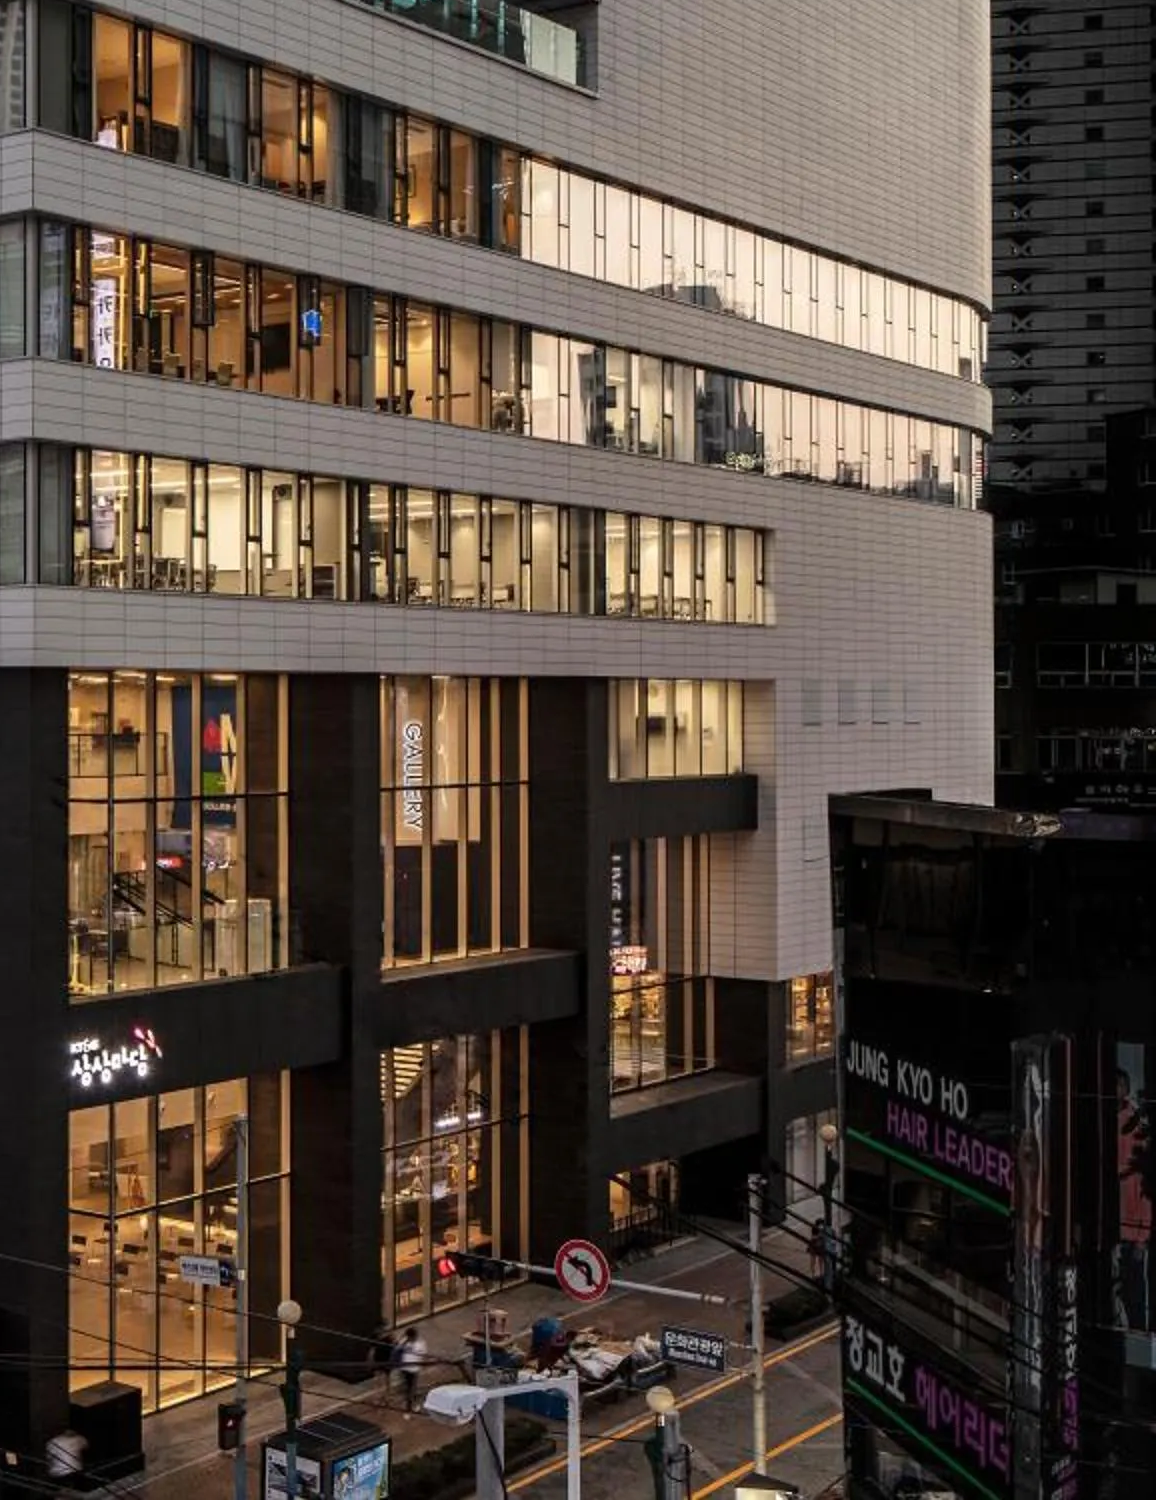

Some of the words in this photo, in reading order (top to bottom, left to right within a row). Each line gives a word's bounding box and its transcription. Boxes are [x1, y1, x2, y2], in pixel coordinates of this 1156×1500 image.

[403, 721, 424, 831] GALLERY
[846, 1040, 890, 1088] JUNG
[897, 1059, 933, 1106] KYO
[940, 1075, 969, 1121] HO
[886, 1100, 929, 1153] HAIR
[845, 1315, 906, 1403] 정교호
[914, 1364, 1012, 1486] 헤어리더
